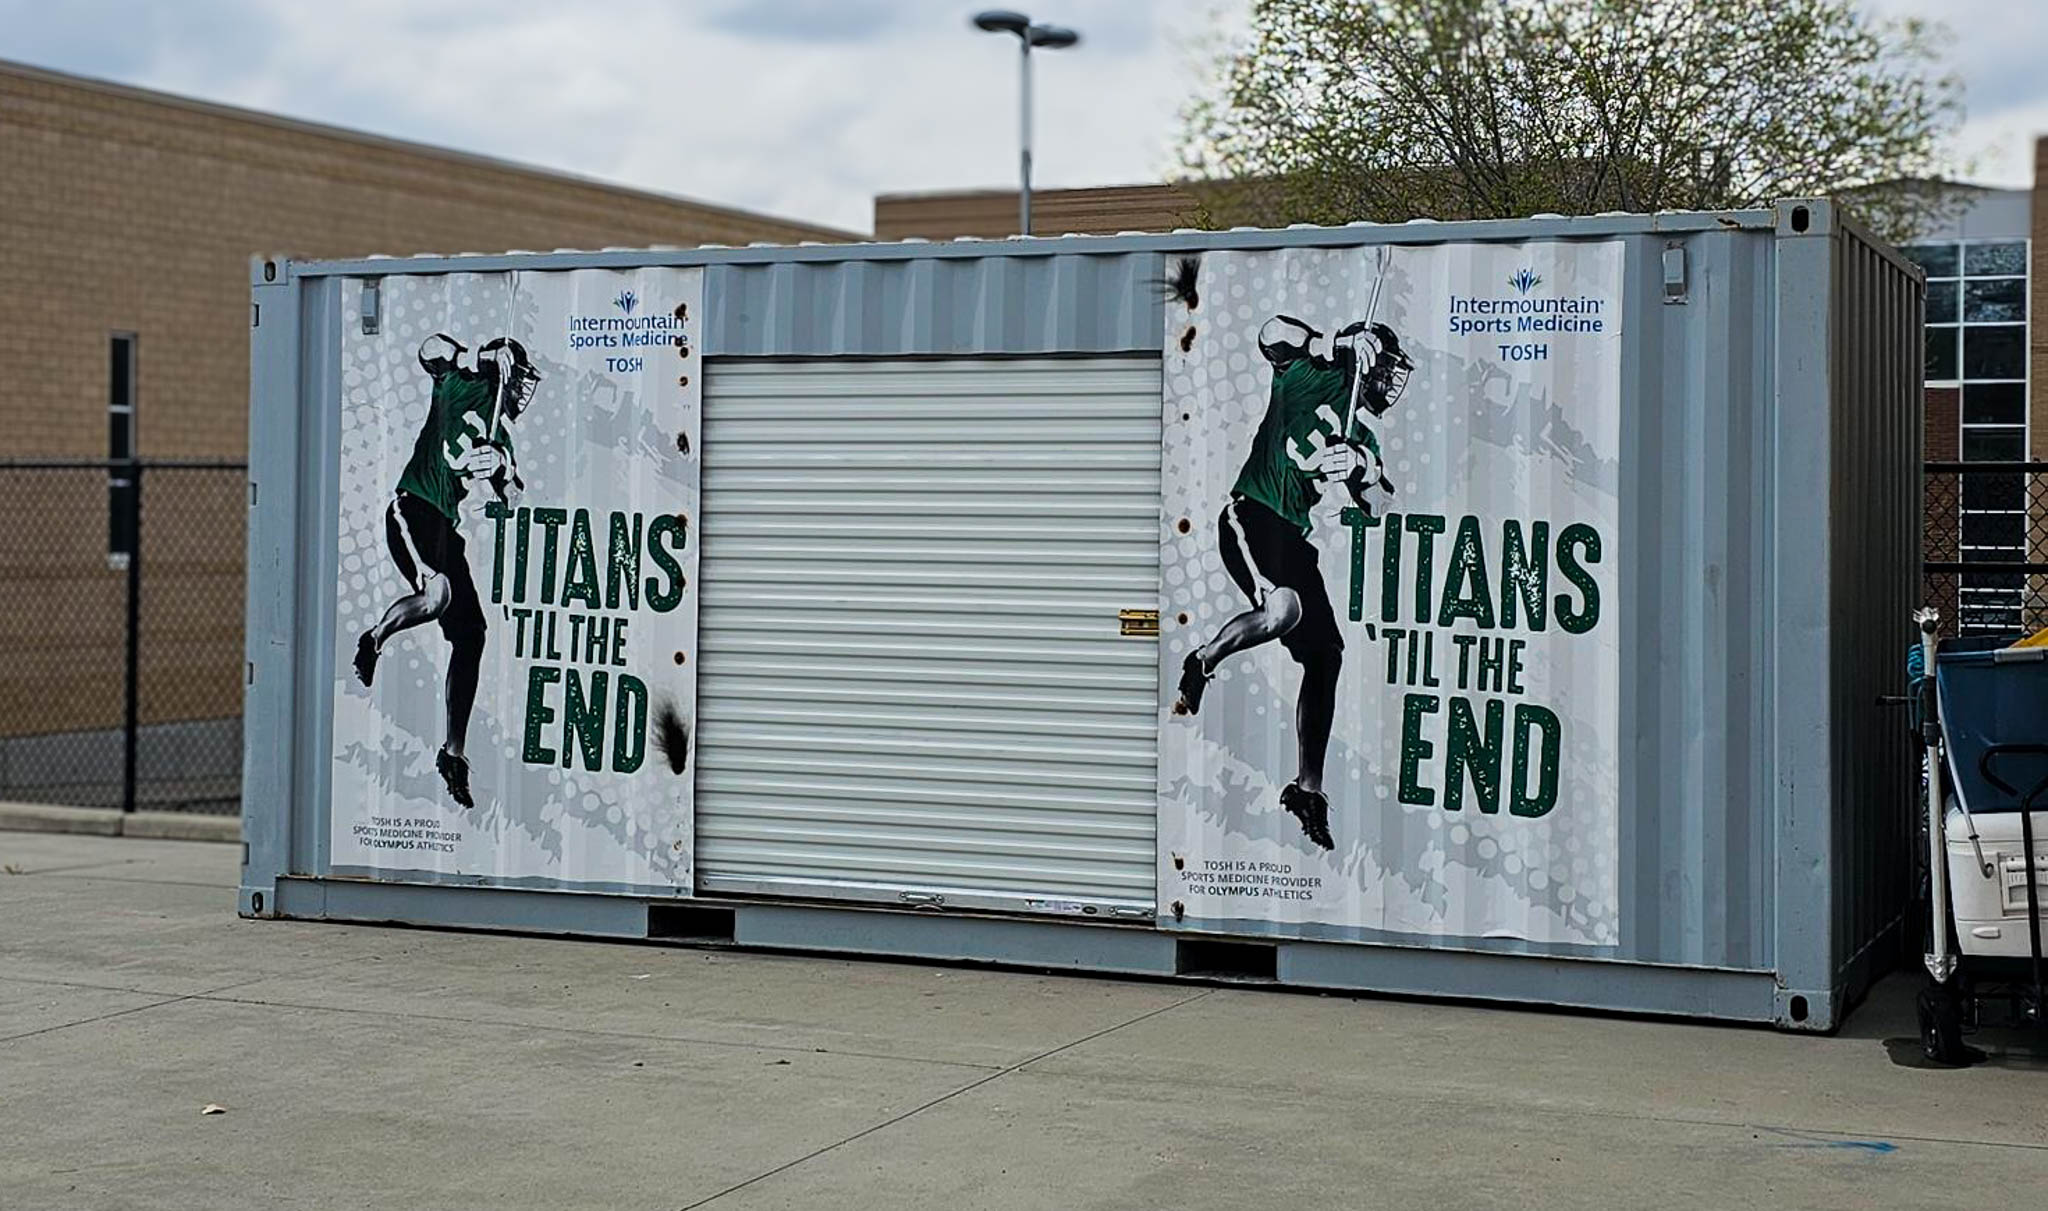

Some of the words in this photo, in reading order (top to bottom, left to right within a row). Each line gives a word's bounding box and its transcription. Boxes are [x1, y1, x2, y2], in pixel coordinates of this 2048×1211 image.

[1450, 295, 1600, 314] Intermountain
[570, 313, 686, 331] Intermountain
[1449, 316, 1511, 336] Sports
[1516, 315, 1603, 332] Medicine
[570, 333, 617, 350] Sports
[622, 330, 688, 347] Medicine
[1498, 343, 1548, 361] TOSH
[605, 357, 643, 373] TOSH
[485, 501, 687, 613] TITANS
[1340, 506, 1602, 635] TITANS
[503, 604, 561, 661] 'TIL
[568, 614, 629, 667] THE
[1364, 622, 1440, 688] 'TIL
[1452, 634, 1526, 695] THE
[522, 665, 648, 774] END
[1398, 692, 1562, 819] END
[403, 819, 412, 828] A
[379, 828, 423, 839] MEDICINE
[374, 838, 414, 850] OLYMPUS
[1204, 860, 1233, 872] TOSH
[1235, 860, 1246, 872] IS
[1248, 861, 1257, 872] A
[1259, 862, 1292, 874] PROUD
[1181, 871, 1215, 883] SPORTS
[1217, 873, 1270, 885] MEDICINE
[1271, 876, 1322, 888] PROVIDER
[1189, 884, 1206, 895] FOR
[1208, 885, 1260, 897] OLYMPUS
